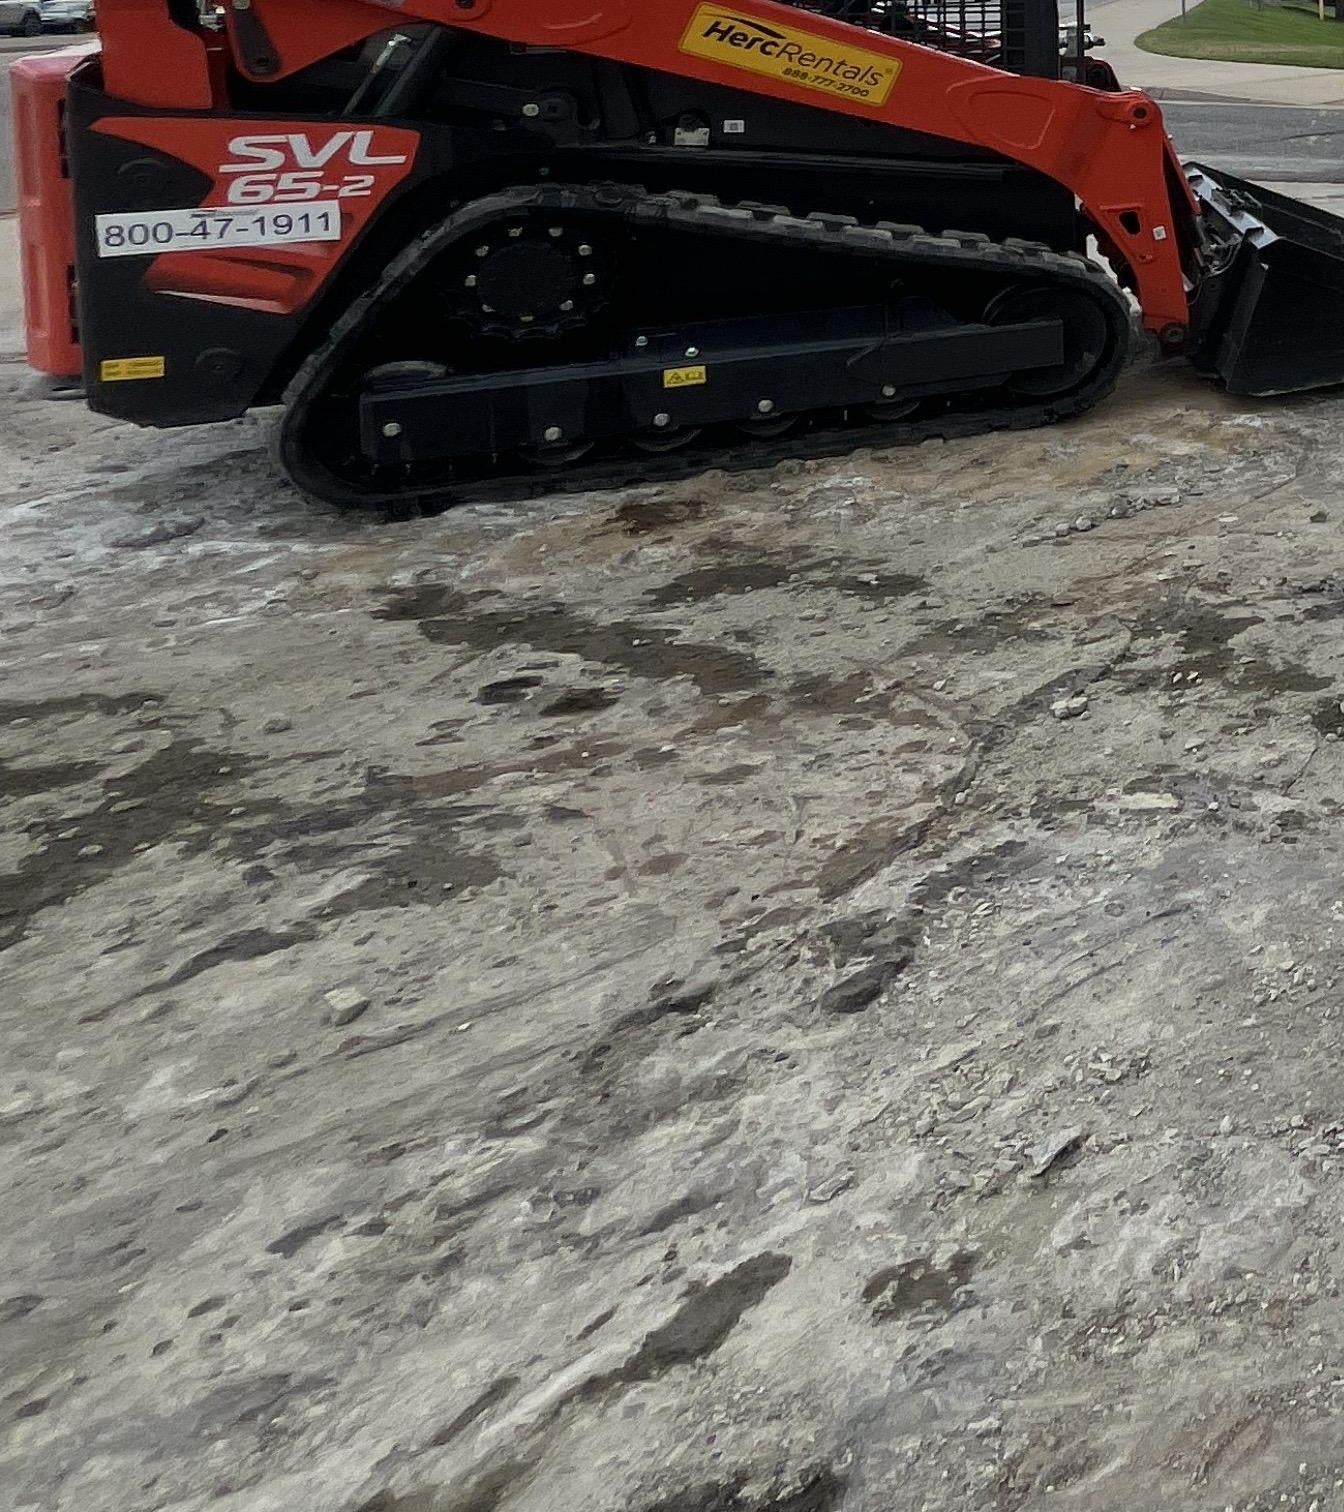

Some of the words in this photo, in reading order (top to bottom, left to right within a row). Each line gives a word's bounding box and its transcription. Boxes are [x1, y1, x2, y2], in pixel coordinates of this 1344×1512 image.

[702, 21, 885, 87] HercRentals
[219, 131, 407, 173] SVL
[227, 171, 375, 205] 65-2
[104, 211, 331, 248] 800-47-1911
